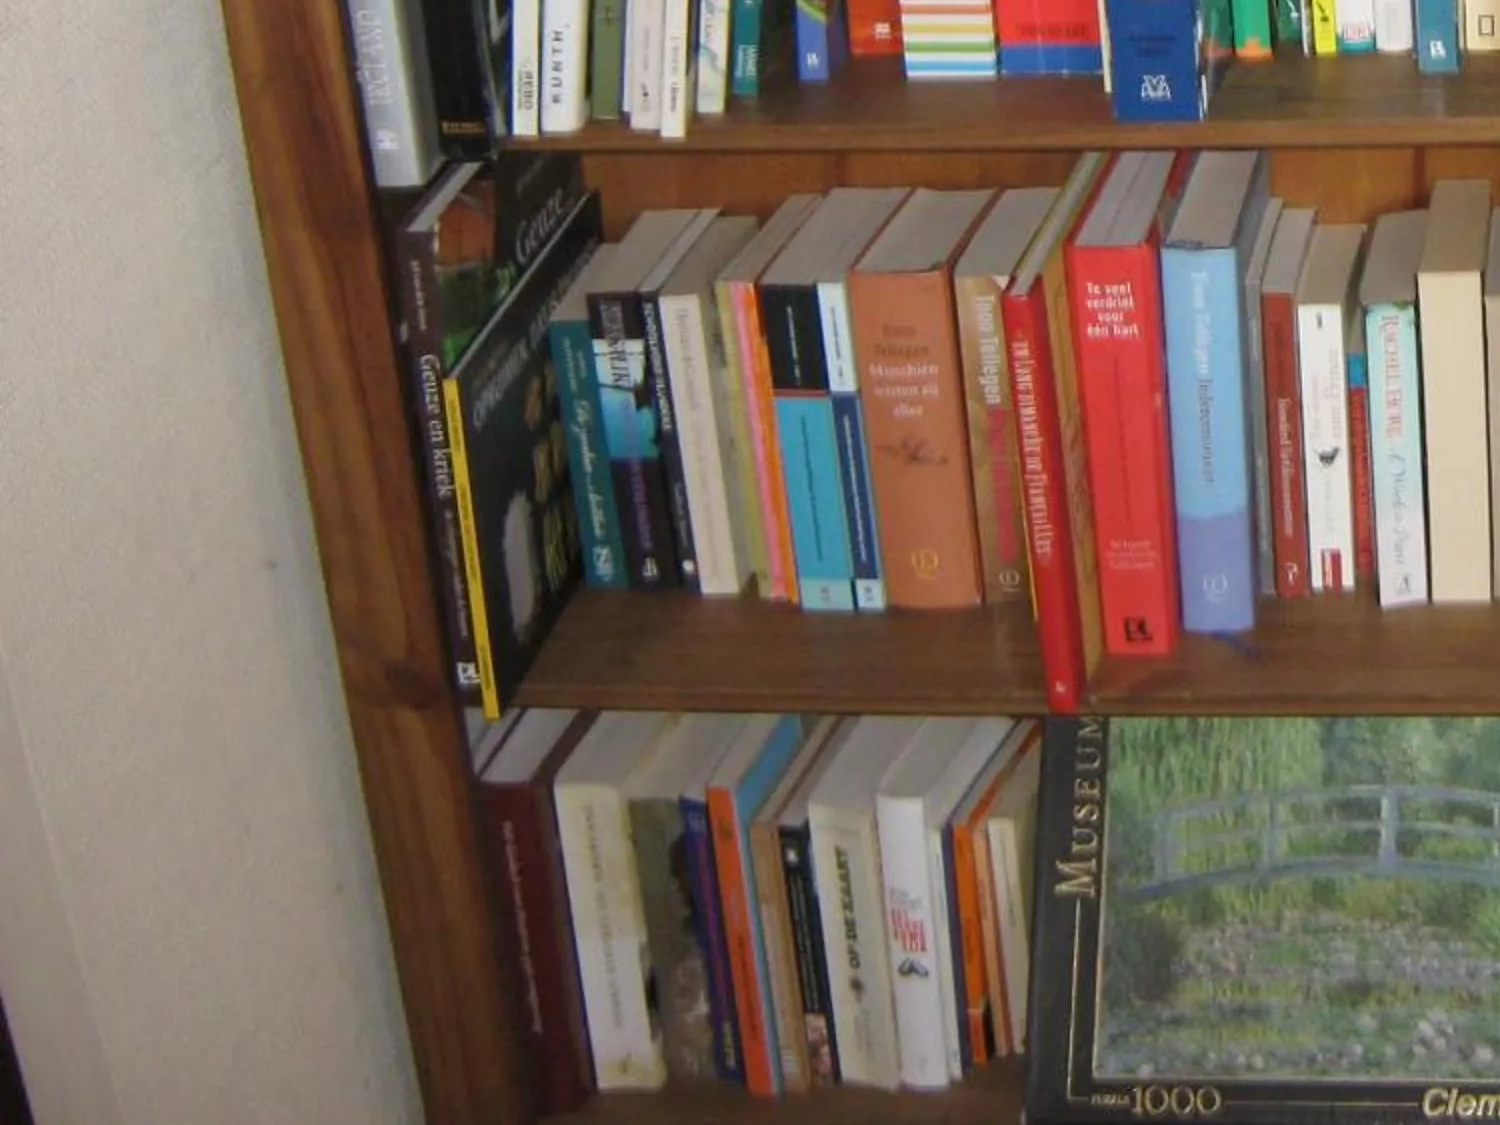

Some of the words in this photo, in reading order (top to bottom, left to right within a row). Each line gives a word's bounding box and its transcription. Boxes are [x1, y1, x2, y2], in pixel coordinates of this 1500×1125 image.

[550, 28, 565, 104] KUNTH
[975, 294, 997, 334] Toon
[418, 353, 444, 415] Geuze
[976, 335, 1003, 405] Tellegen
[428, 419, 445, 443] en
[430, 447, 456, 499] kriek
[1053, 715, 1104, 899] MUSEUM
[1132, 1085, 1222, 1116] 1000
